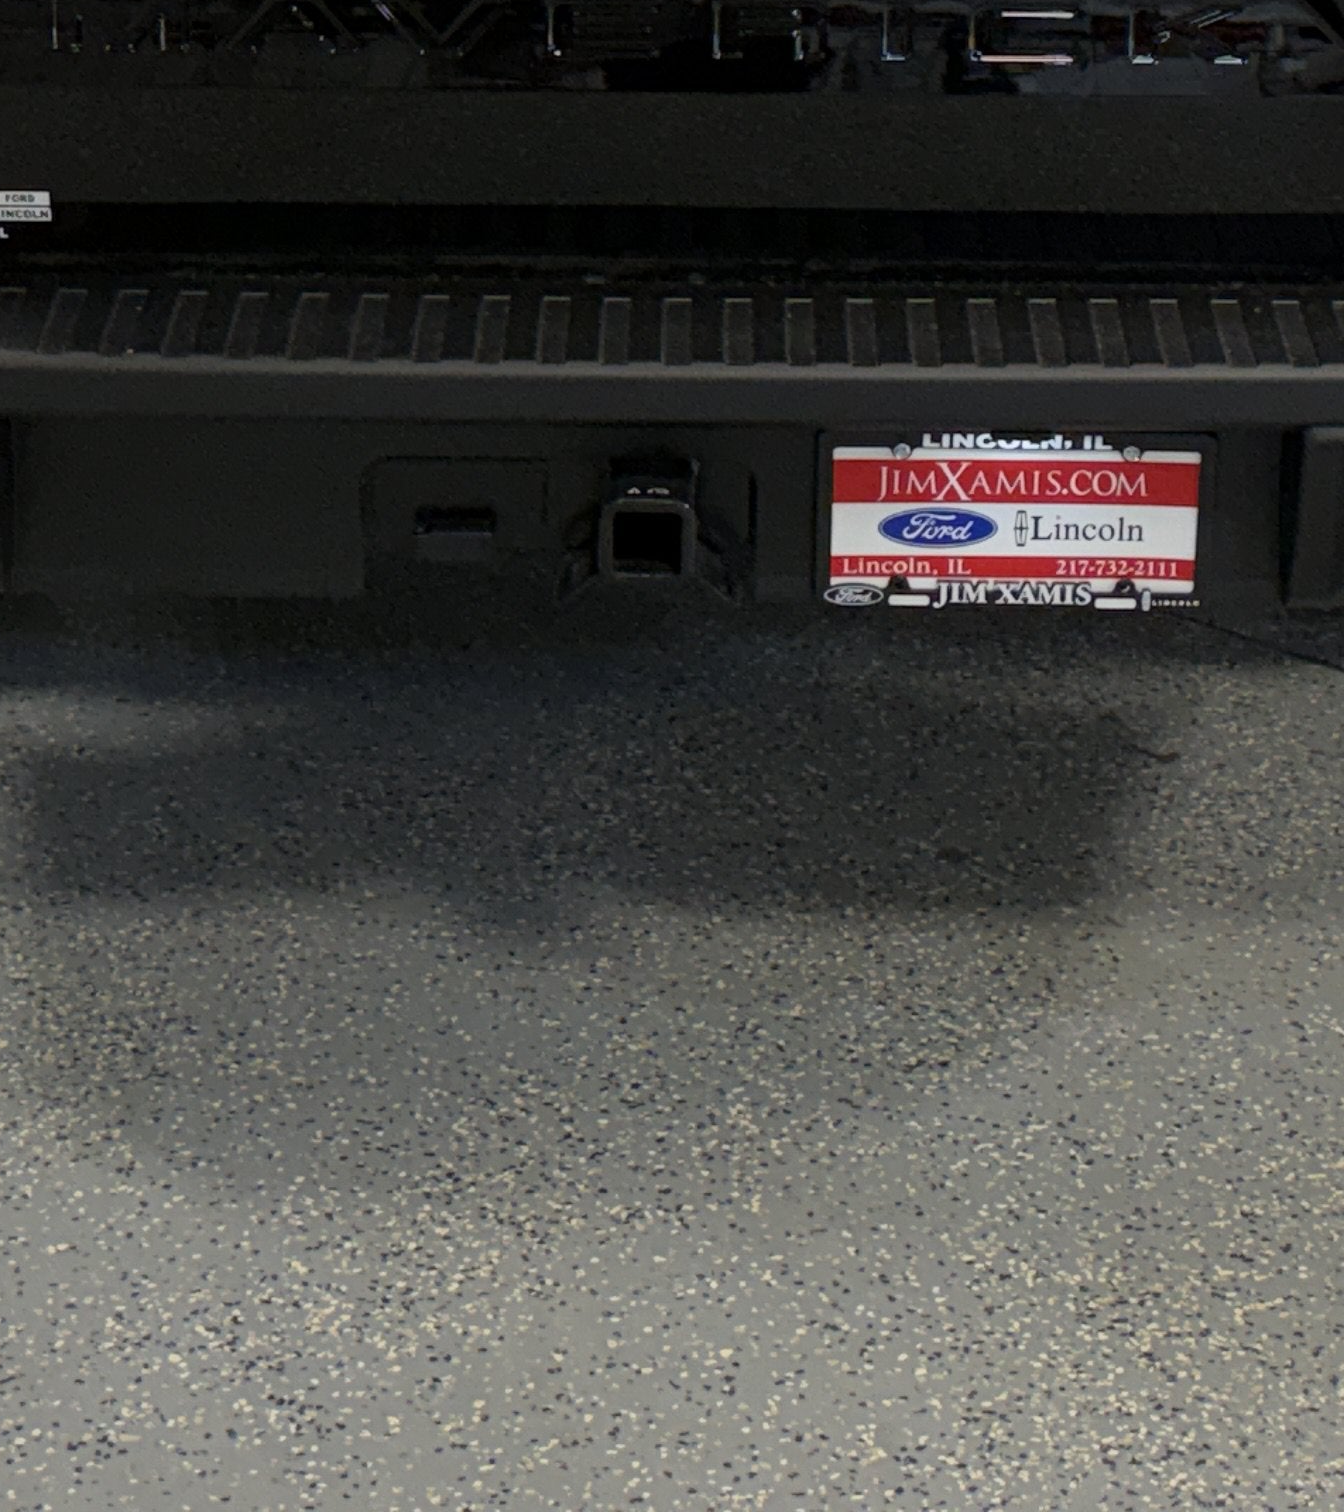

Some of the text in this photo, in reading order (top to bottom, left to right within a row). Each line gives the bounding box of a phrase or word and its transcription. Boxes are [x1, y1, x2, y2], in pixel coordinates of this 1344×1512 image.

[4, 193, 36, 203] FORD
[1082, 435, 1113, 450] IL
[901, 512, 1144, 542] Ford Lincoln
[947, 558, 972, 576] IL
[1055, 559, 1180, 579] 217-732-2111
[932, 581, 988, 609] JIM
[994, 581, 1093, 607] XAMIS
